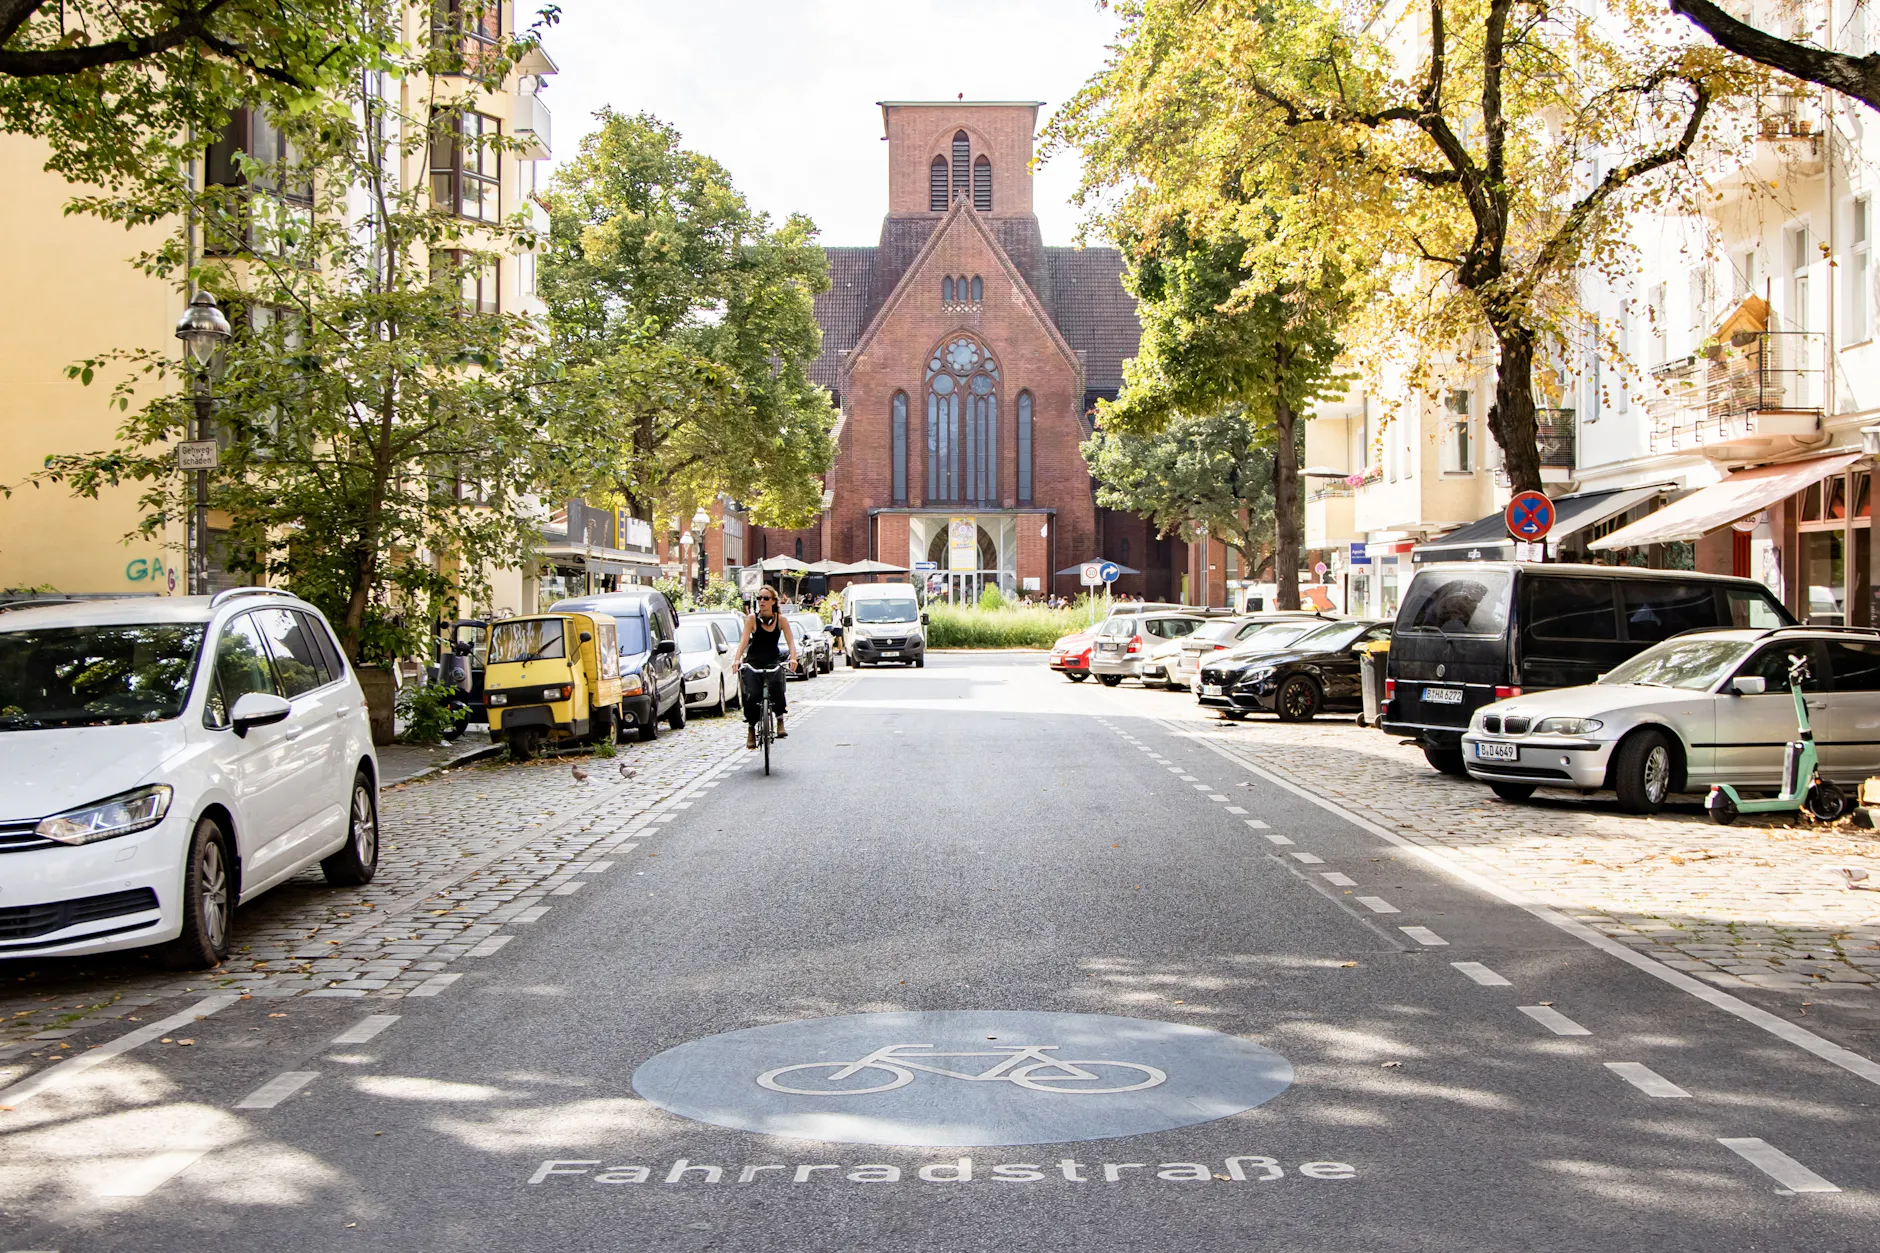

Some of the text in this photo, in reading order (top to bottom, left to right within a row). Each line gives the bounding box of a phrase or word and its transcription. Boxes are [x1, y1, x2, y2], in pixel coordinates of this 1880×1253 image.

[182, 446, 213, 455] Gehweg-
[1445, 690, 1462, 701] 6272
[1495, 745, 1513, 757] 4649
[527, 1156, 1357, 1185] Fahrradstraße
